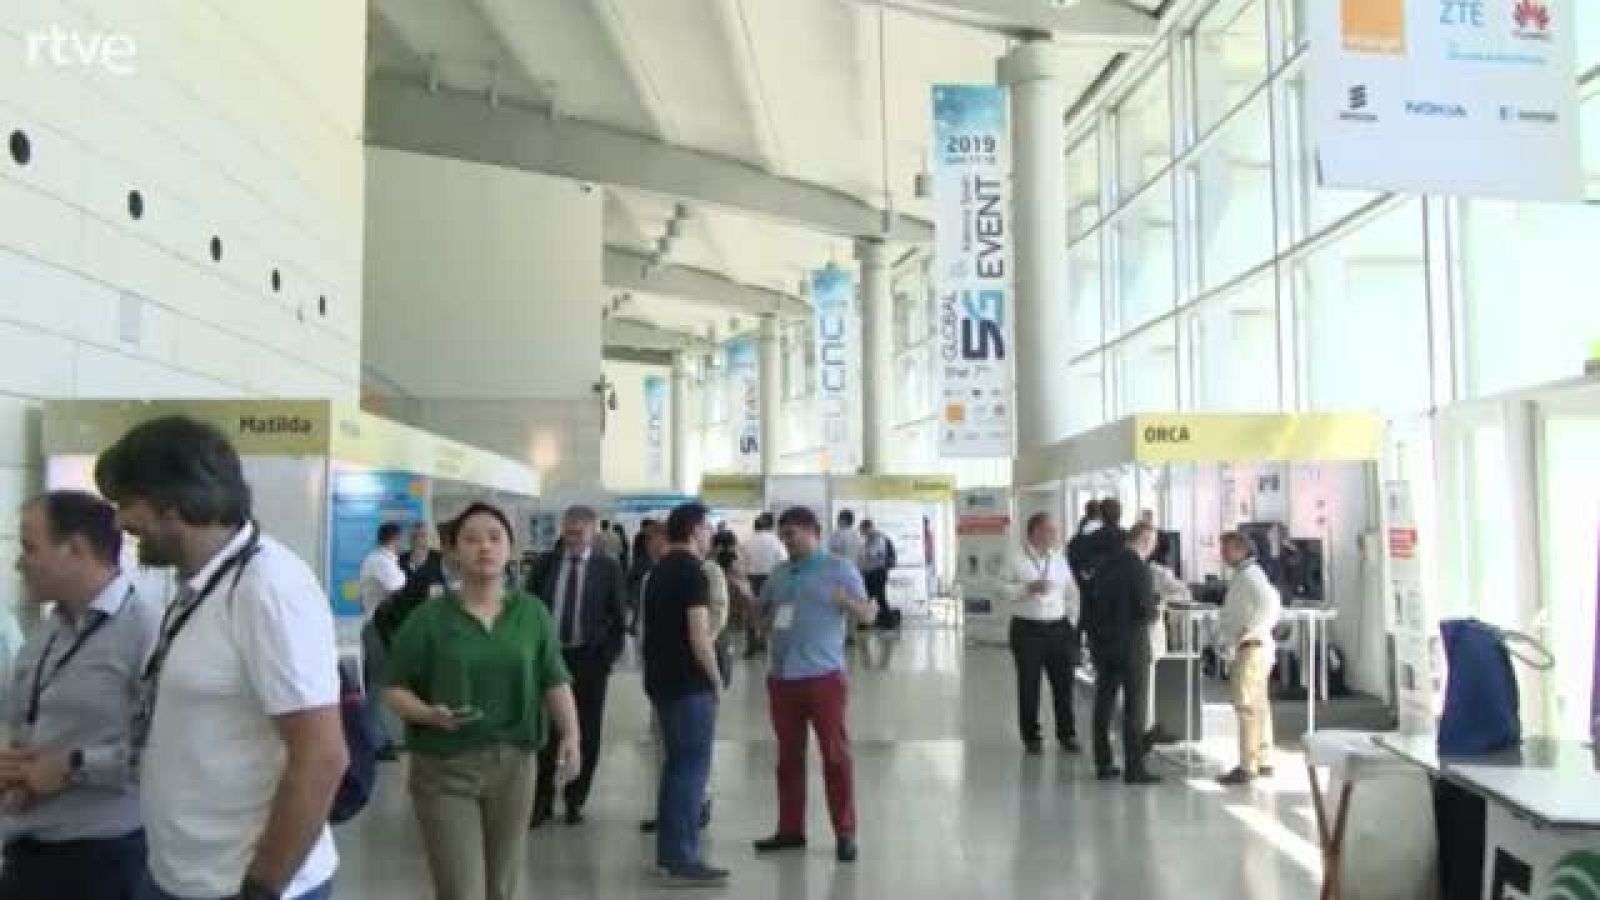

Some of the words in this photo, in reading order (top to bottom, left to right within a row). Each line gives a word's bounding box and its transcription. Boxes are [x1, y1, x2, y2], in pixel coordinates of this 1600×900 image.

[1440, 2, 1483, 25] ZTE
[947, 135, 996, 152] 2019
[975, 174, 1003, 278] EVENT
[961, 289, 1005, 361] 5G
[240, 415, 311, 434] Matilda
[1144, 426, 1190, 443] ORCA
